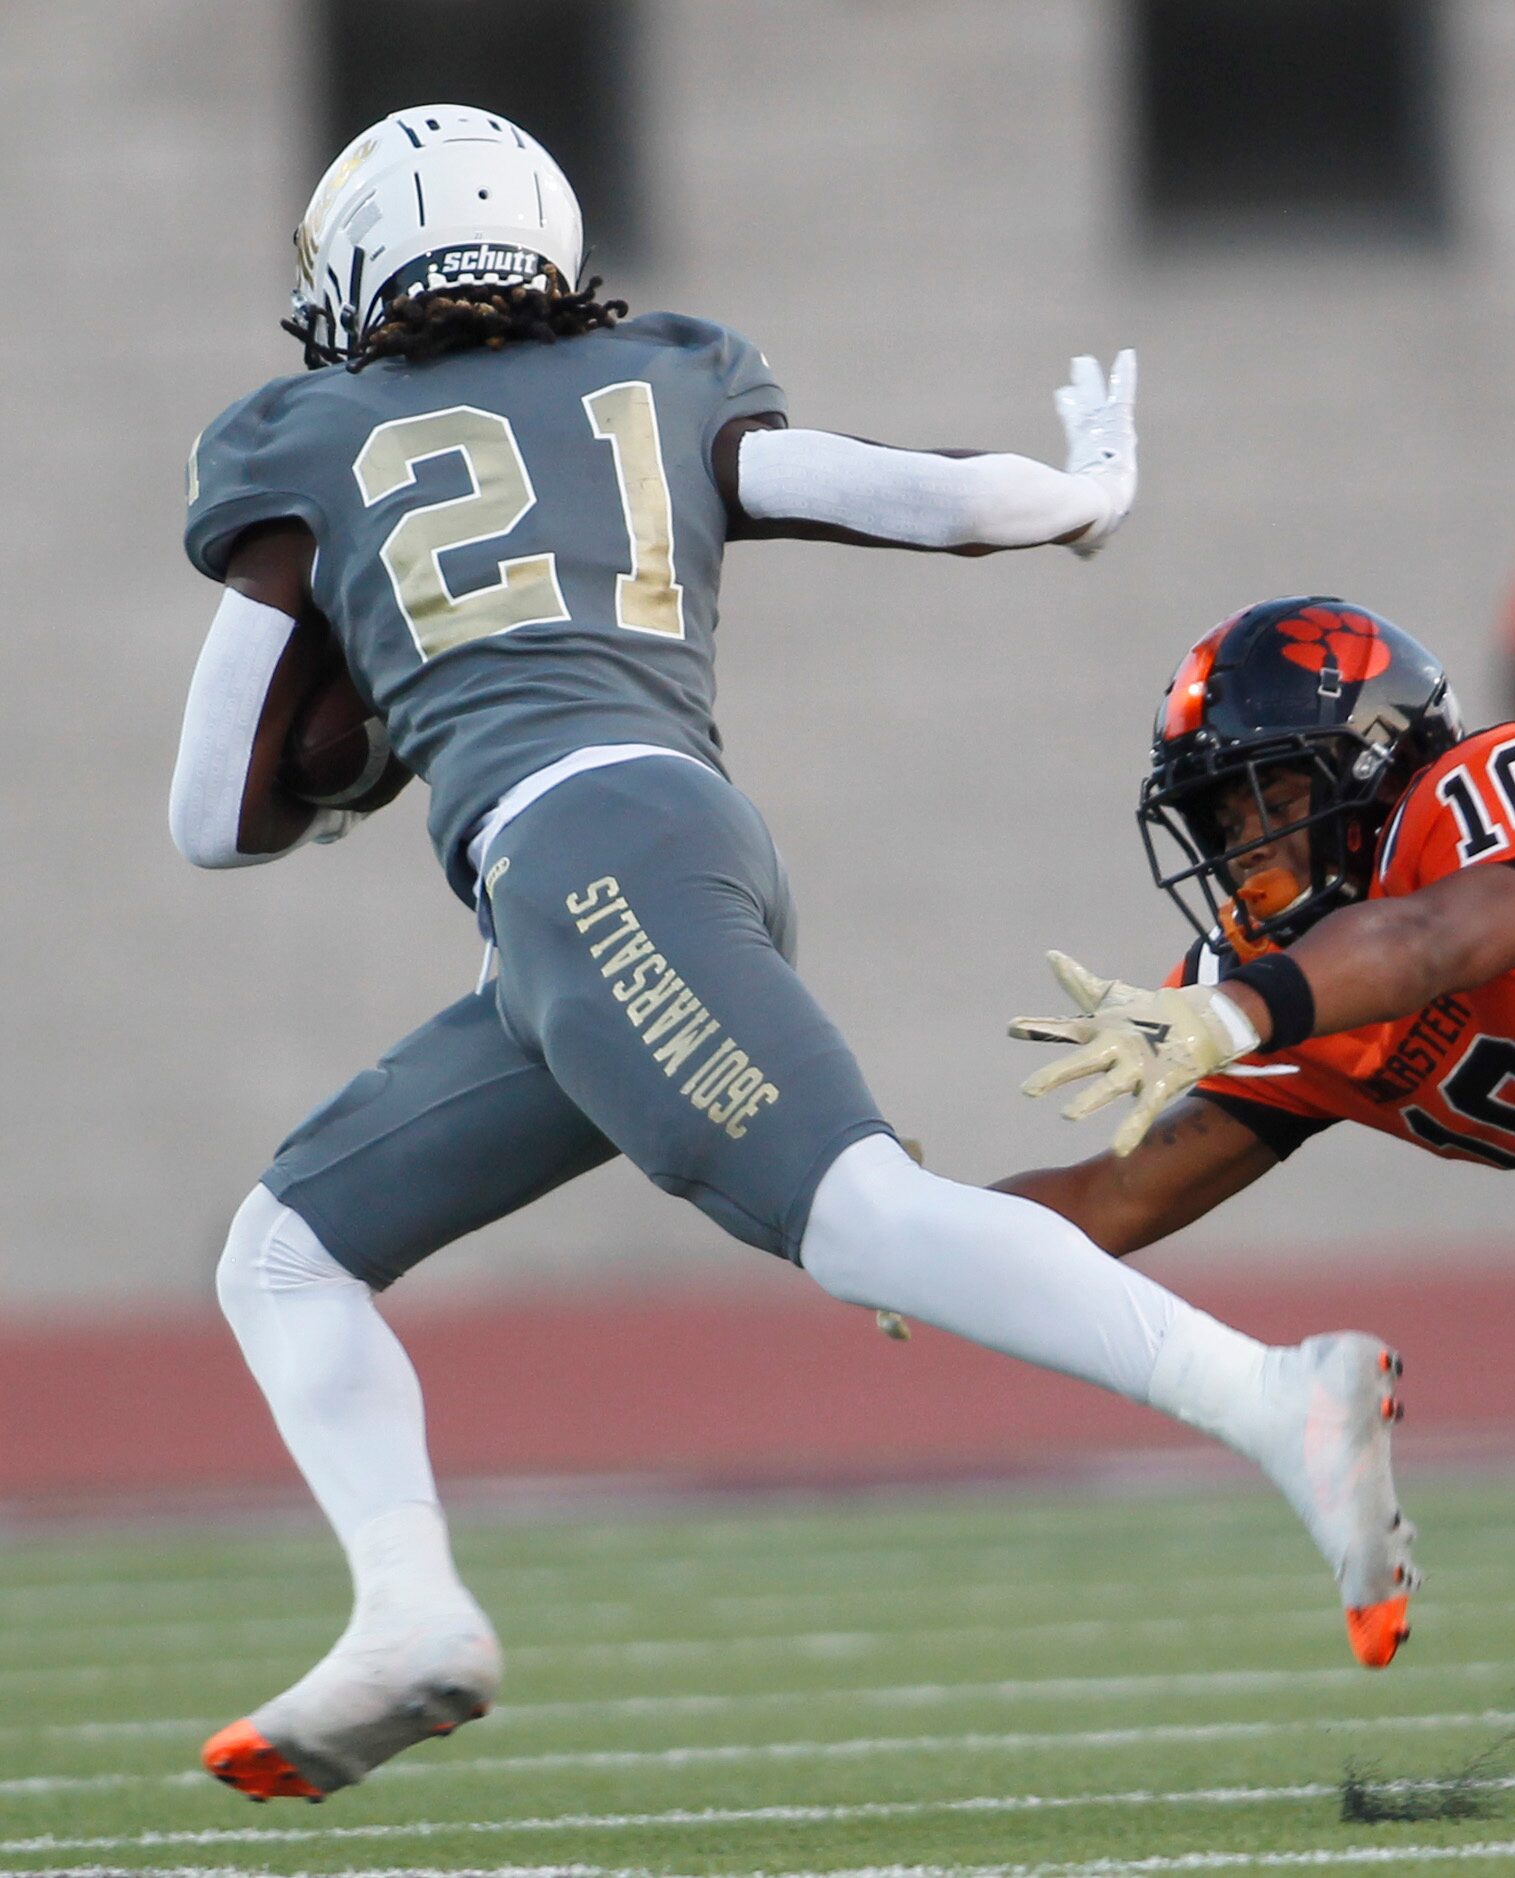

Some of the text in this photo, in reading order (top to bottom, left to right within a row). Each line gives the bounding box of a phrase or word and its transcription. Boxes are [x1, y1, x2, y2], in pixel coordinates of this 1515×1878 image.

[442, 244, 538, 274] schutt
[352, 381, 686, 664] 21
[565, 875, 780, 1140] 3601 MARSALIS
